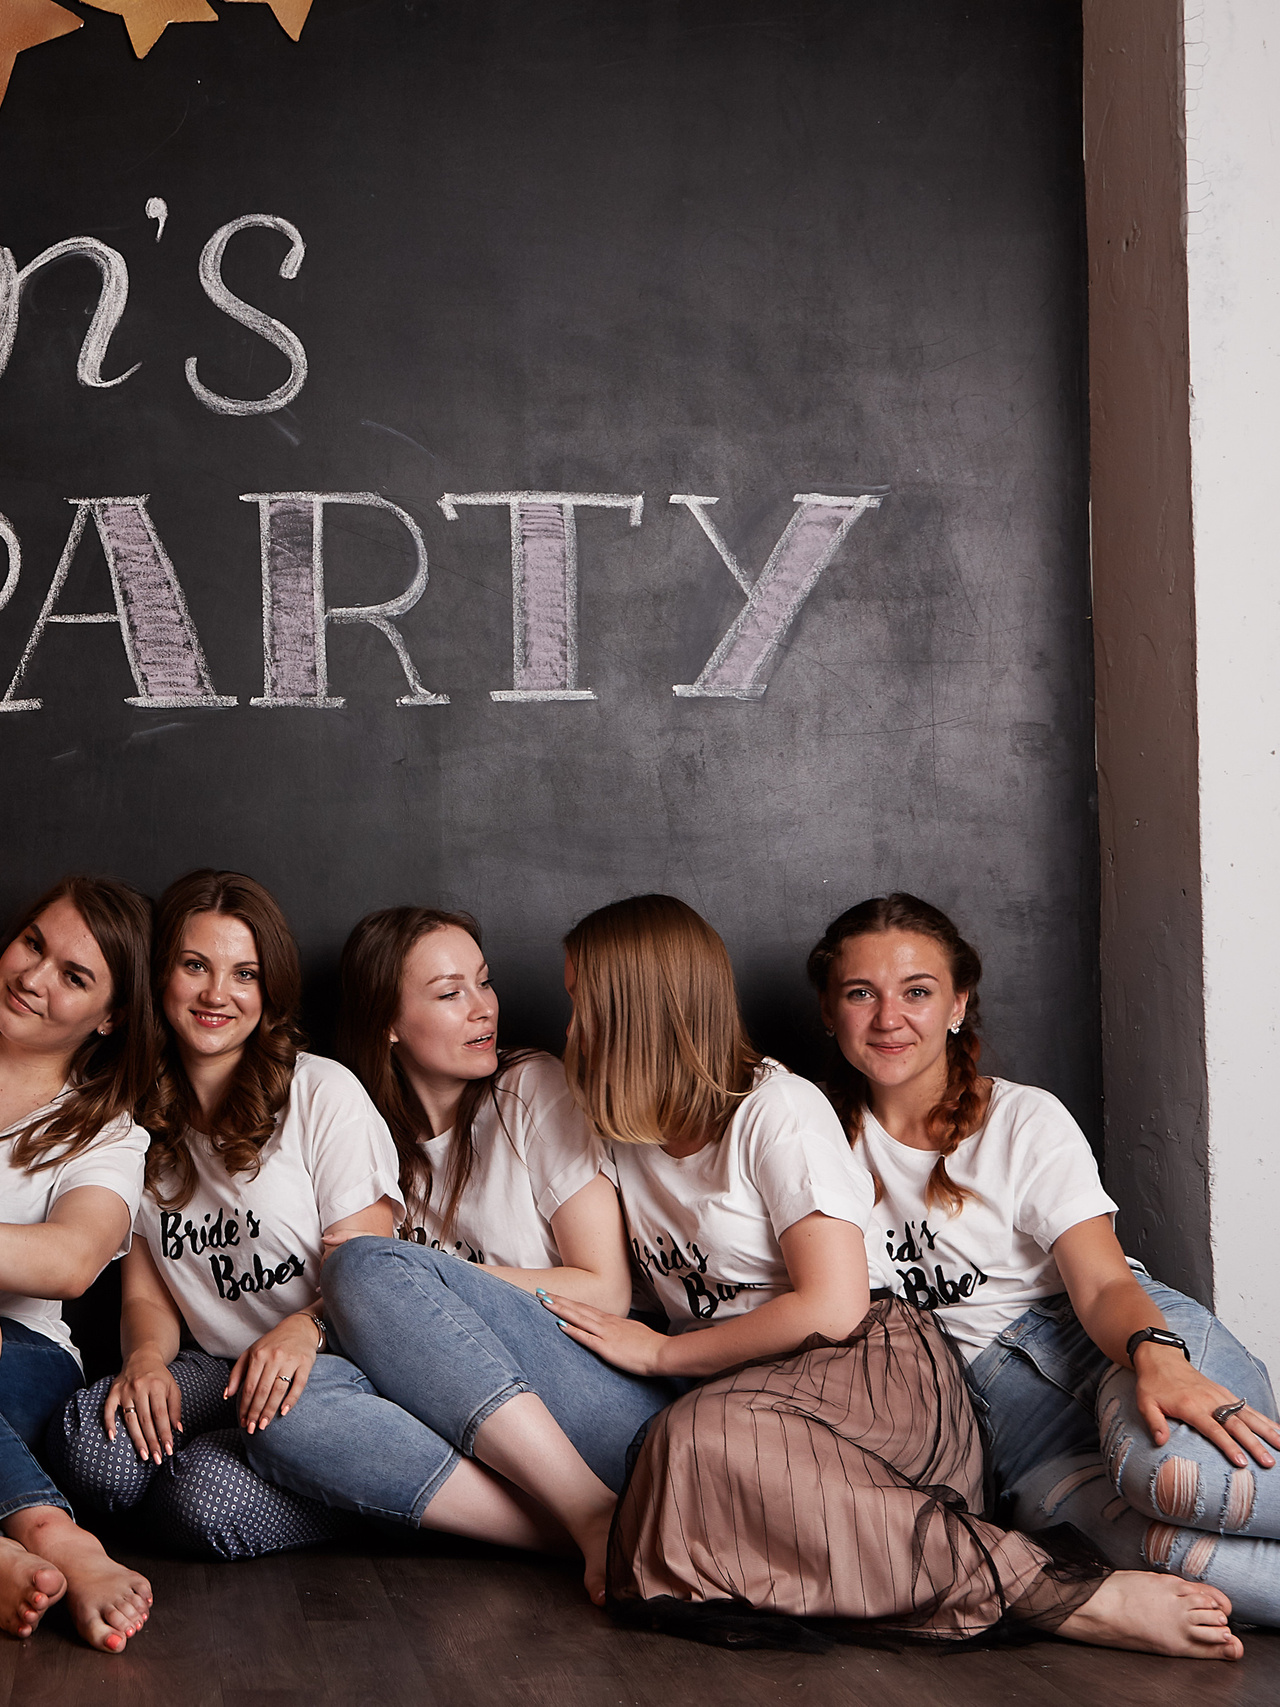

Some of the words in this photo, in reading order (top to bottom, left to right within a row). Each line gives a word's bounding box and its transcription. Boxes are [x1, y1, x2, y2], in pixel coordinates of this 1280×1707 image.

[160, 1207, 261, 1260] Bride's
[208, 1253, 306, 1302] Babes
[895, 1264, 989, 1311] Bbes
